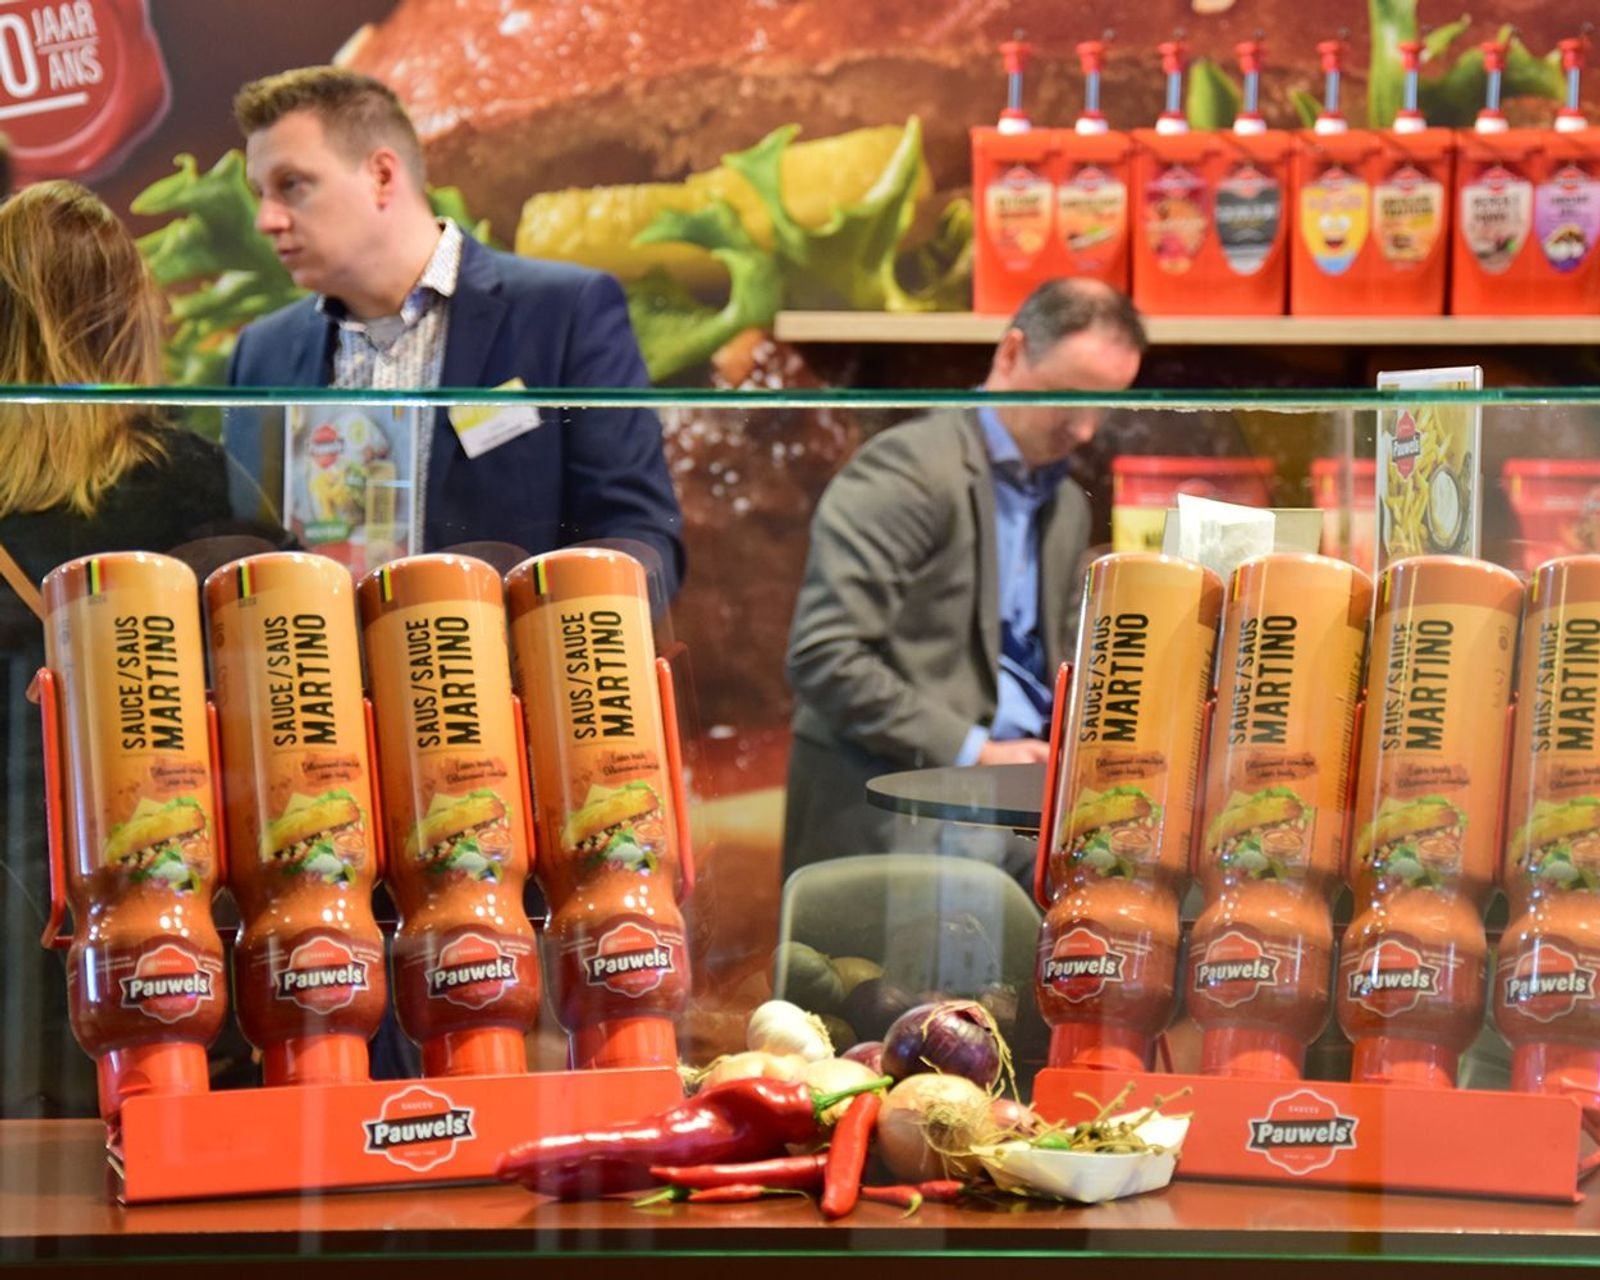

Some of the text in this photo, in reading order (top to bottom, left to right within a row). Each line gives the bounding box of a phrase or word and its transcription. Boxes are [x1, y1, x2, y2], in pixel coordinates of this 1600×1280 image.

[31, 0, 98, 47] JAAR
[48, 45, 103, 91] ANS
[142, 615, 185, 751] MARTINO
[292, 613, 337, 745] MARTINO
[434, 616, 482, 745] MARTINO
[589, 610, 635, 738] MARTINO
[1102, 613, 1149, 743] MARTINO
[1250, 615, 1298, 744] MARTINO
[1405, 619, 1454, 751] MARTINO
[1556, 618, 1600, 751] MARTINO
[284, 965, 363, 991] Pauwels
[434, 959, 512, 988] Pauwels
[594, 948, 669, 977] Pauwels
[1046, 958, 1117, 978] Pauwels
[1200, 959, 1271, 981] Pauwels
[1353, 969, 1431, 993] Pauwels
[130, 974, 208, 999] Pauwels
[1509, 973, 1587, 997] Pauwels
[374, 1113, 467, 1145] Pauwels
[1257, 1120, 1349, 1144] Pauwels
